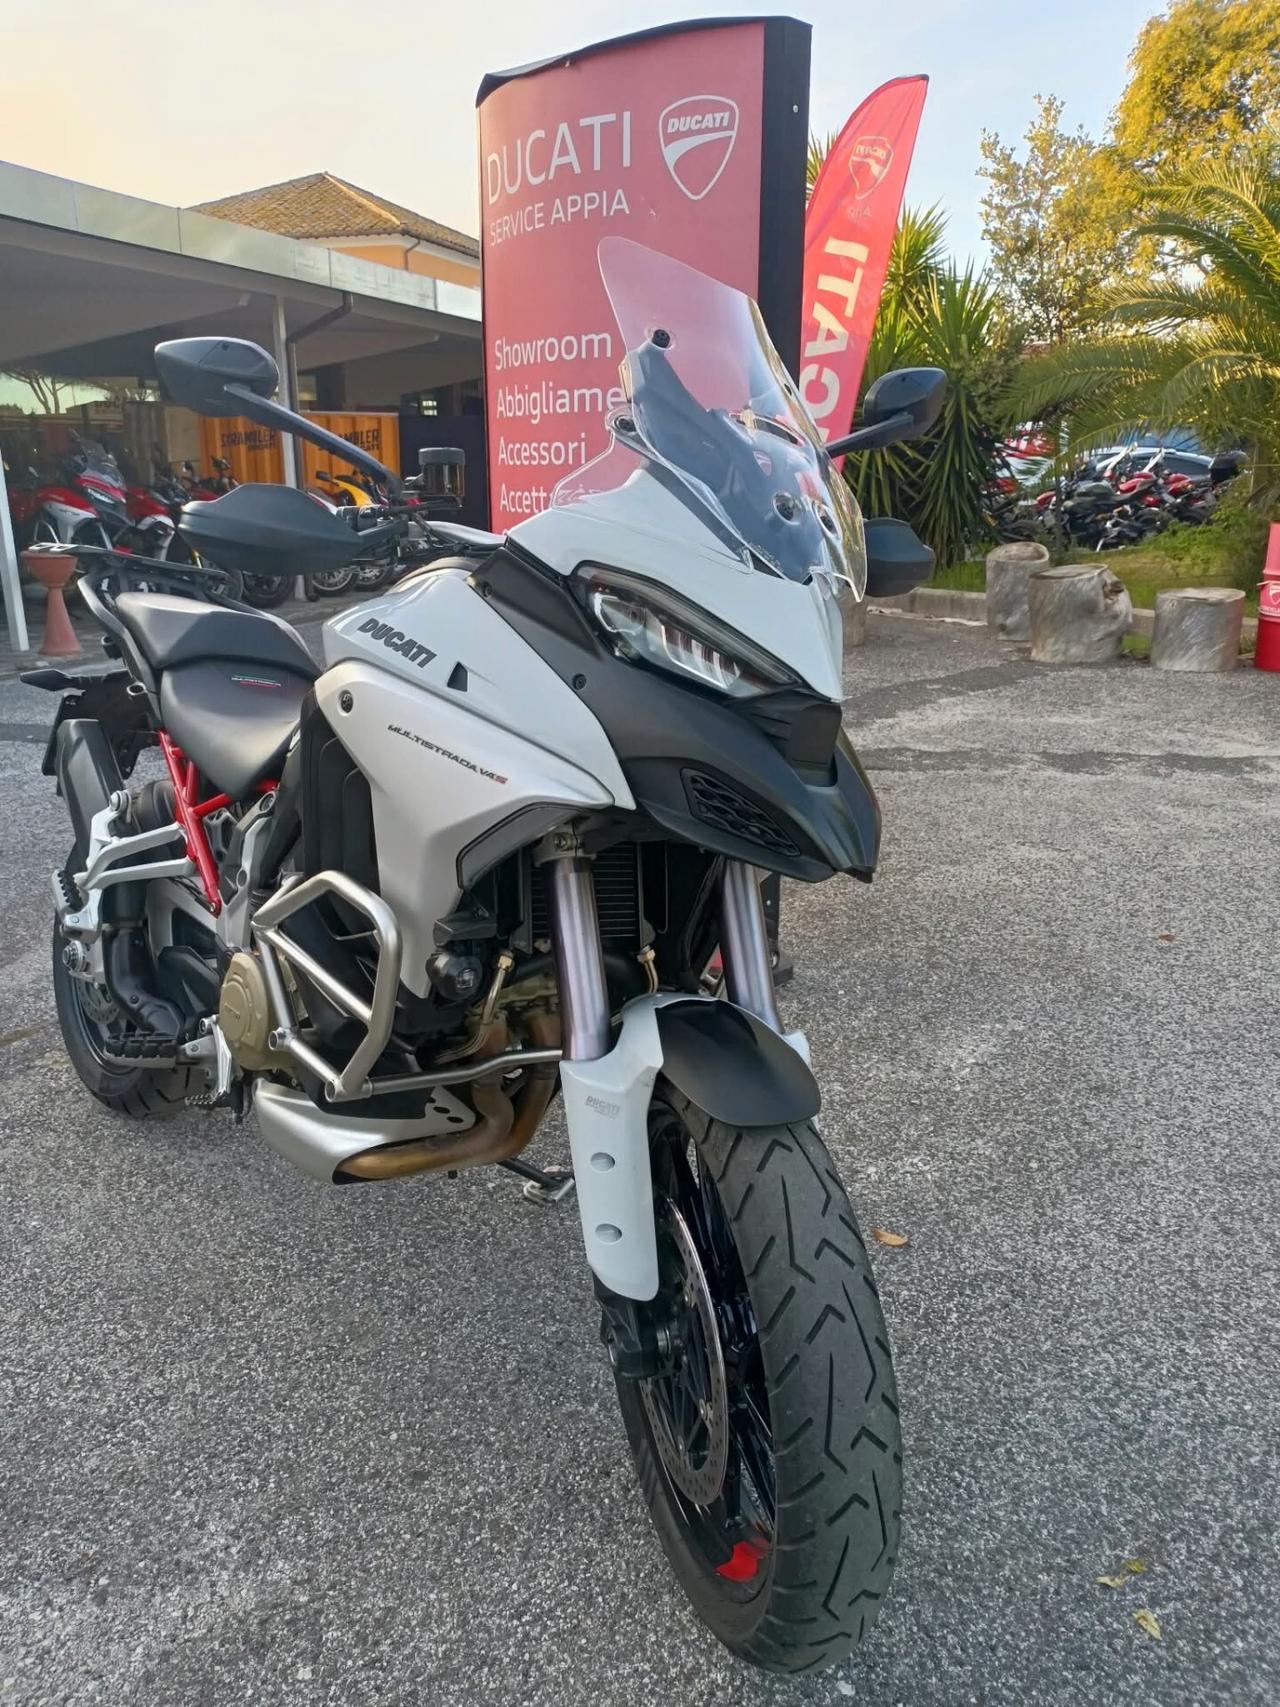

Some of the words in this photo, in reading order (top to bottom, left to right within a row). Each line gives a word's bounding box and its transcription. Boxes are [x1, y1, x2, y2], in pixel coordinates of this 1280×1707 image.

[667, 111, 730, 134] DUCATI
[487, 111, 631, 206] DUCATI
[489, 202, 545, 247] SERVICE
[550, 188, 630, 225] APPIA
[494, 332, 612, 371] Showroom
[498, 432, 586, 465] Accessori
[357, 617, 437, 668] DUCATI
[387, 724, 478, 773] MULTISTRADA
